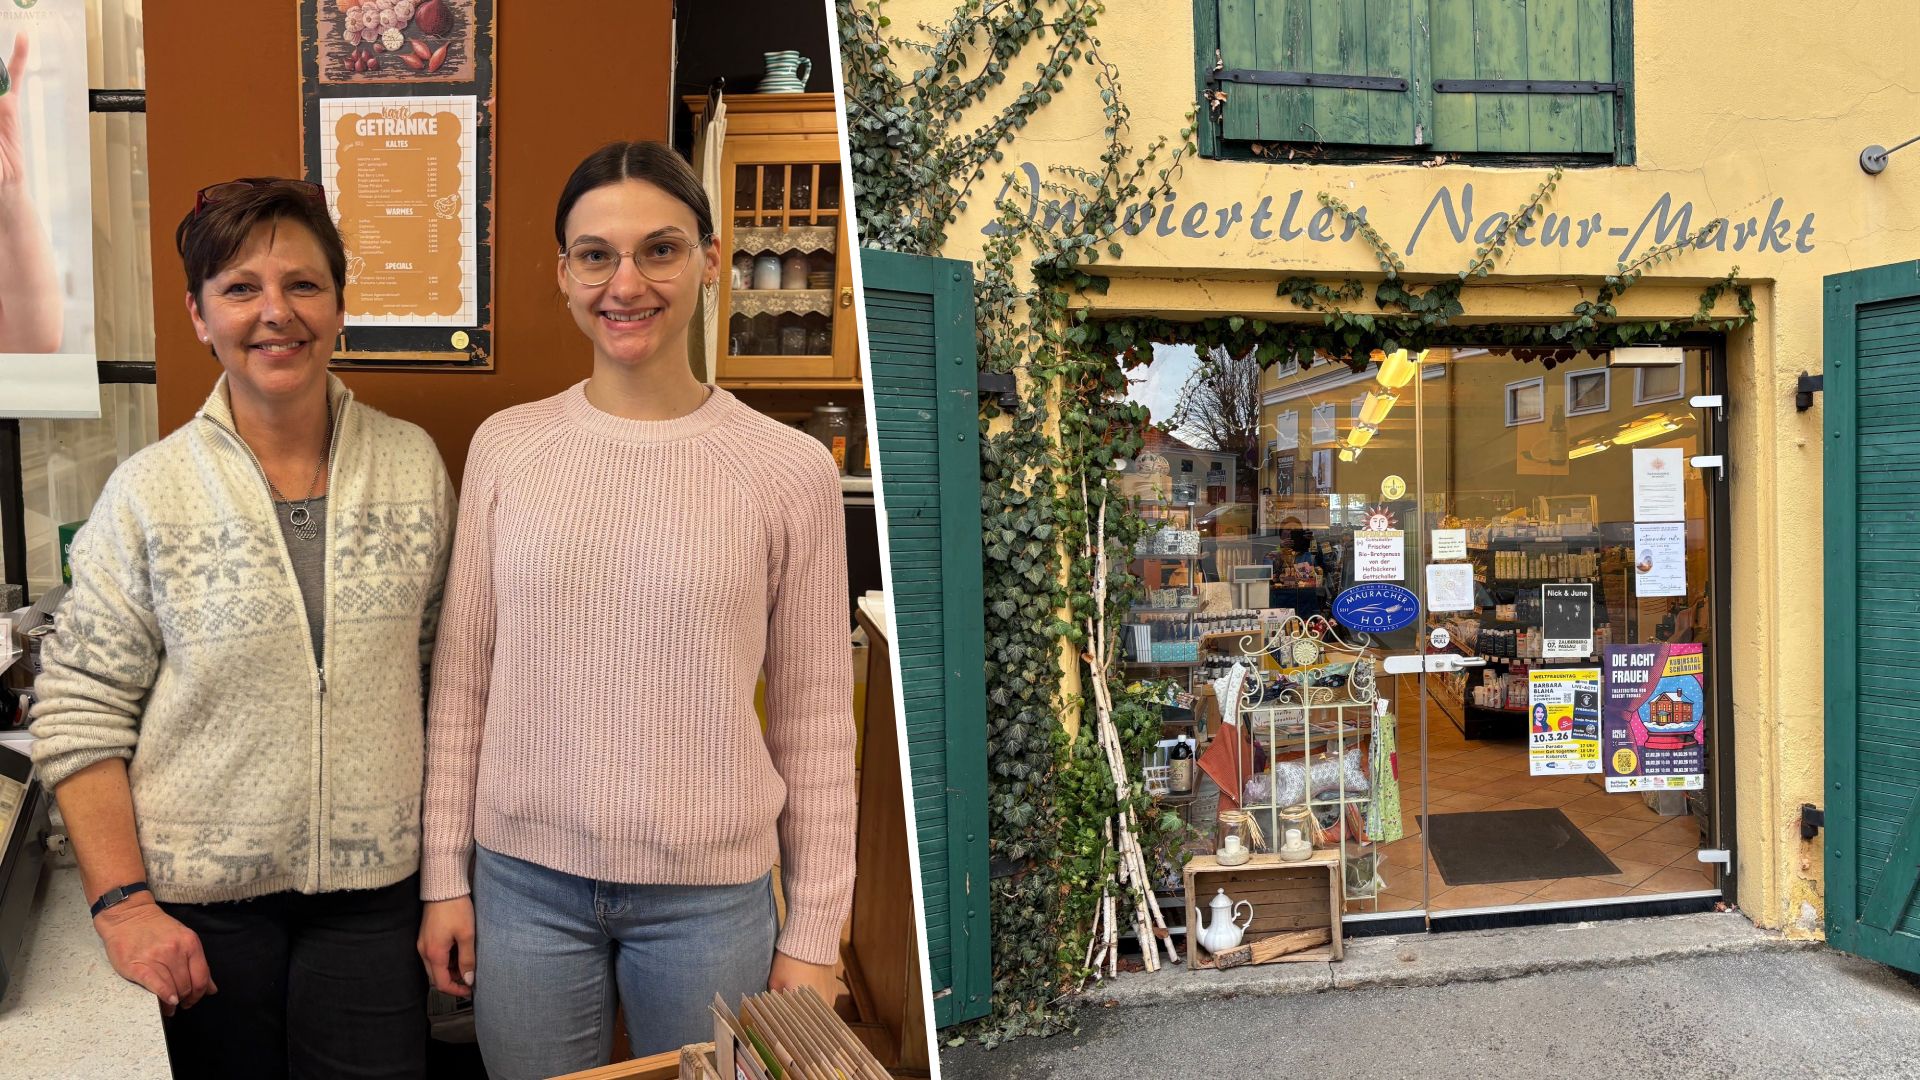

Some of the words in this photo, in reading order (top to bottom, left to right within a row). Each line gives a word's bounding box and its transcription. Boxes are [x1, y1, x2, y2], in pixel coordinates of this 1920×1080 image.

[385, 140, 409, 148] KALTES
[1395, 183, 1816, 263] Natur-Markt
[384, 262, 413, 270] SPECIALS
[1346, 590, 1408, 605] MAURACHER
[1547, 589, 1563, 597] Nick
[1563, 589, 1569, 597] &
[1570, 589, 1588, 597] June
[1360, 615, 1393, 626] HOF
[1611, 653, 1628, 667] DIE
[1630, 653, 1656, 667] ACHT
[1611, 669, 1649, 683] FRAUEN
[1533, 732, 1569, 743] 10.3.26
